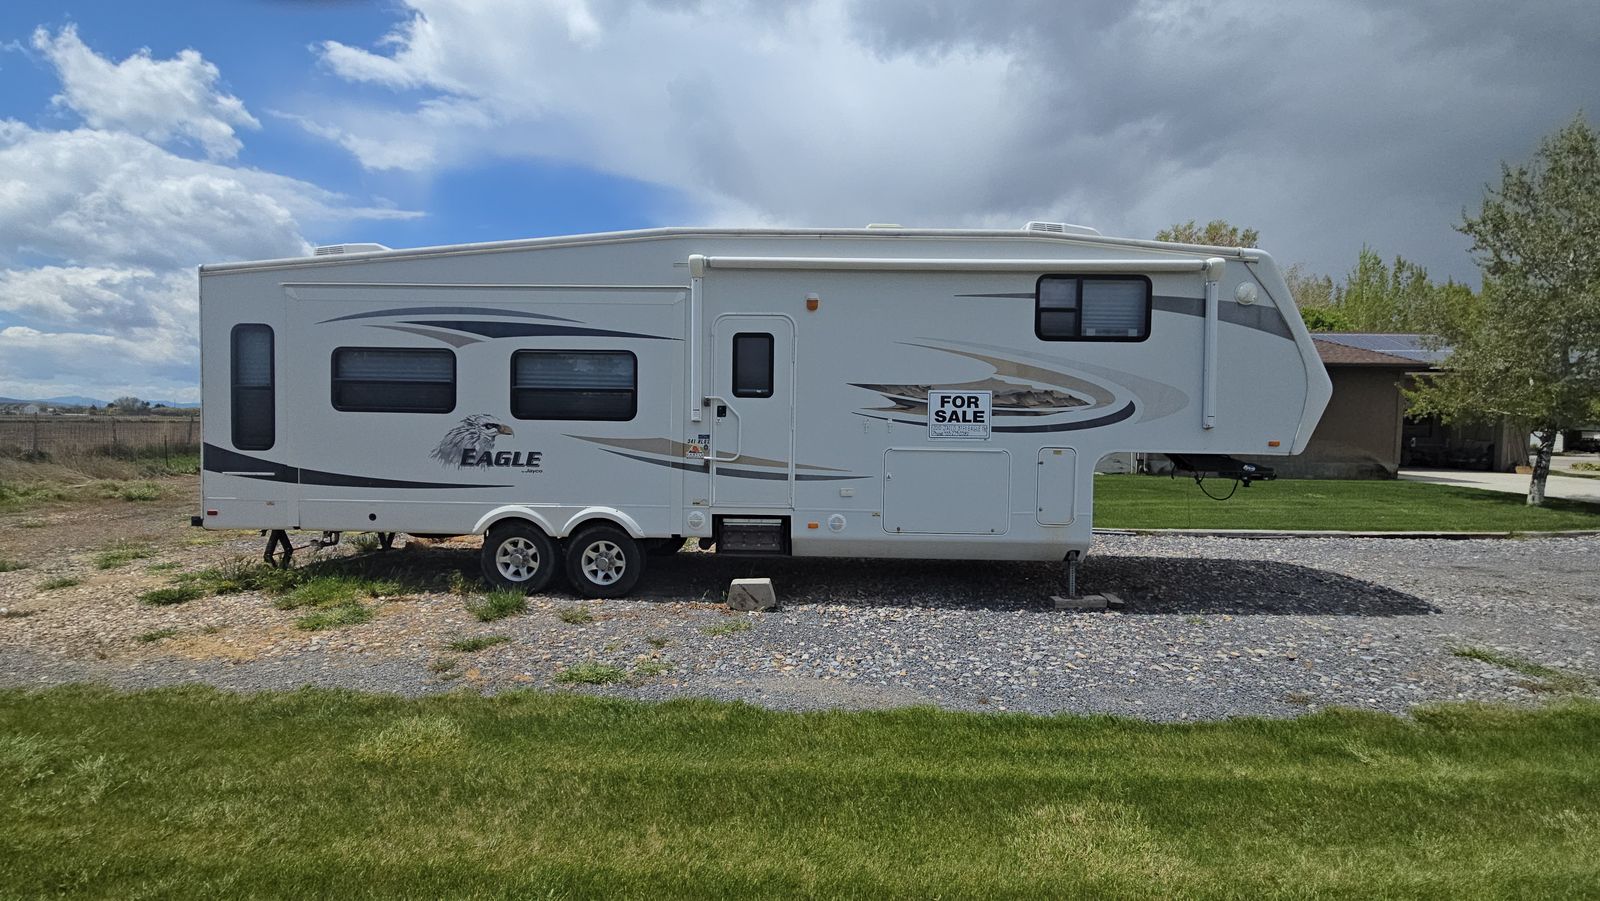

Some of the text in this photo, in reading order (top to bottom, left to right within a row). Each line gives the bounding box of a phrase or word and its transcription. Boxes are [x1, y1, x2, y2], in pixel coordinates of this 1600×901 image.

[940, 395, 979, 408] FOR
[934, 410, 985, 423] SALE
[460, 447, 543, 468] EAGLE
